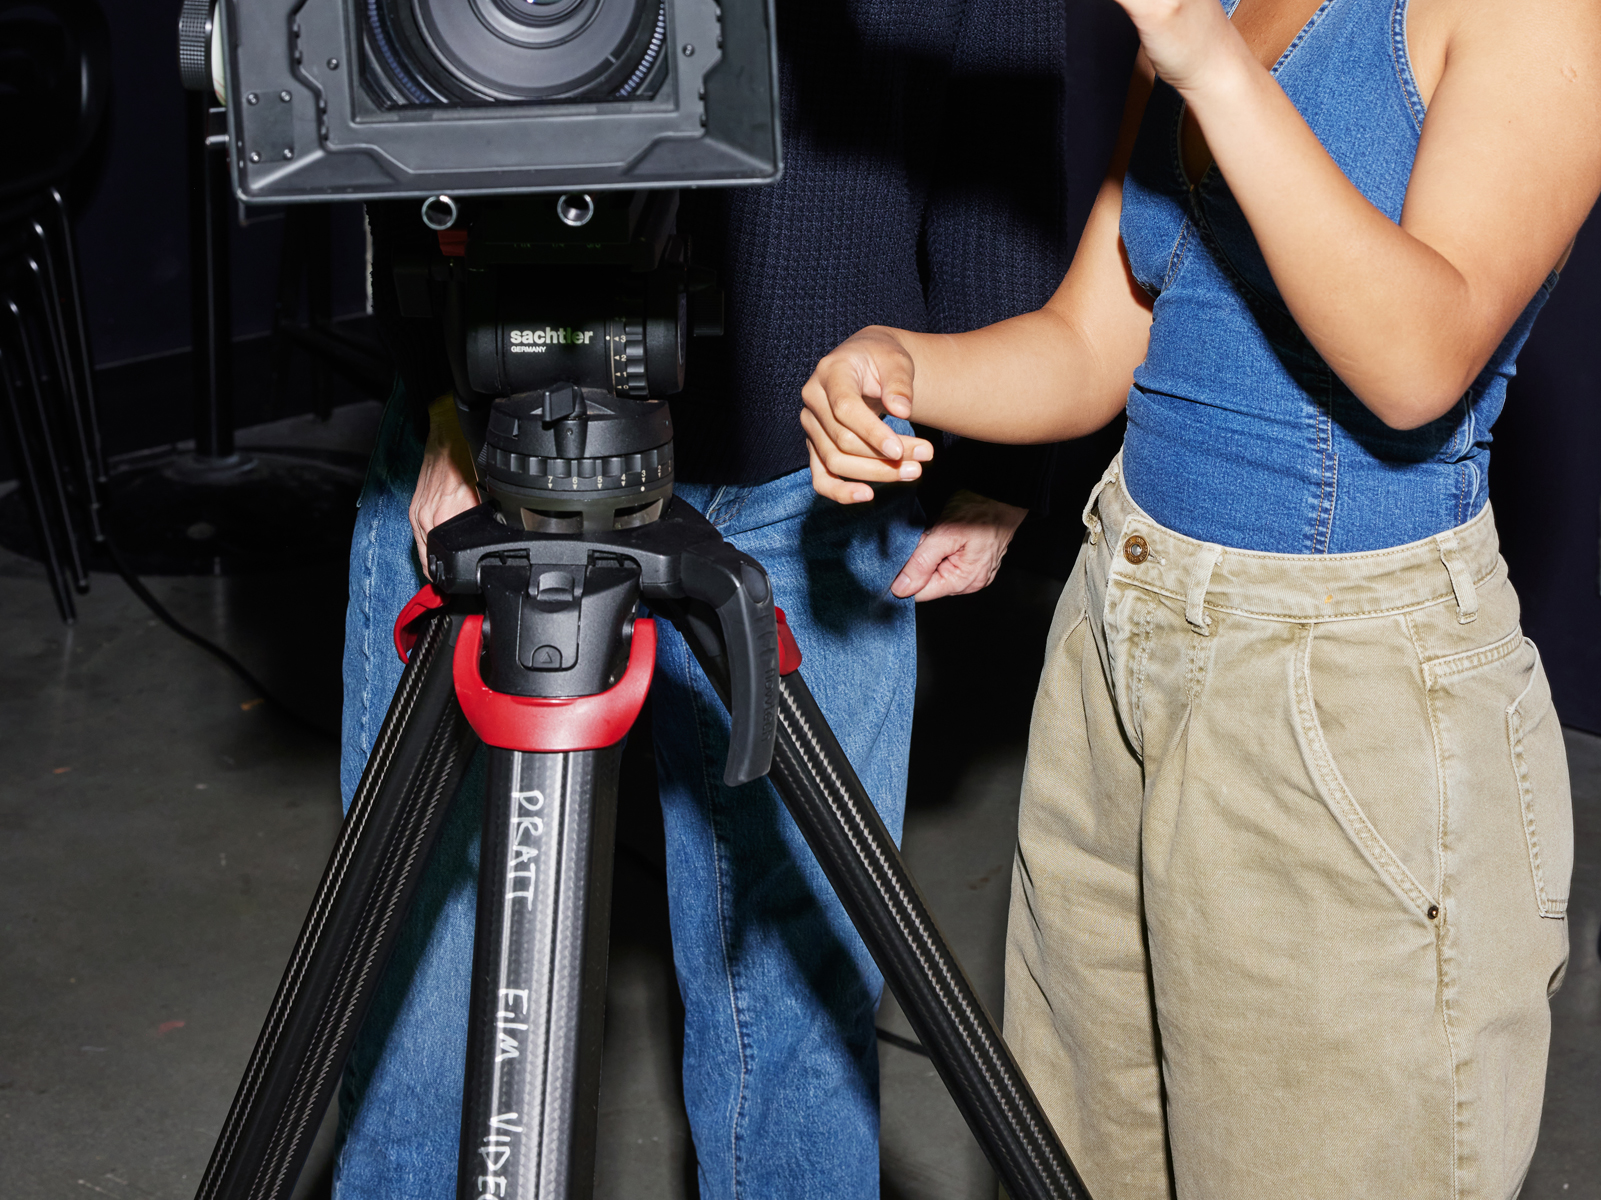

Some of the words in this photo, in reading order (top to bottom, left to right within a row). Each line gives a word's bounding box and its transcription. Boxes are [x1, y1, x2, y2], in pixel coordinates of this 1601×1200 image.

[510, 326, 594, 344] sachtler
[620, 335, 627, 343] 3
[510, 345, 547, 353] GERMANY
[621, 354, 627, 362] 2
[547, 475, 554, 484] 7
[572, 476, 578, 484] 6
[597, 475, 603, 484] 5
[620, 473, 627, 481] 4
[641, 469, 647, 477] 3
[505, 790, 544, 912] PRATT
